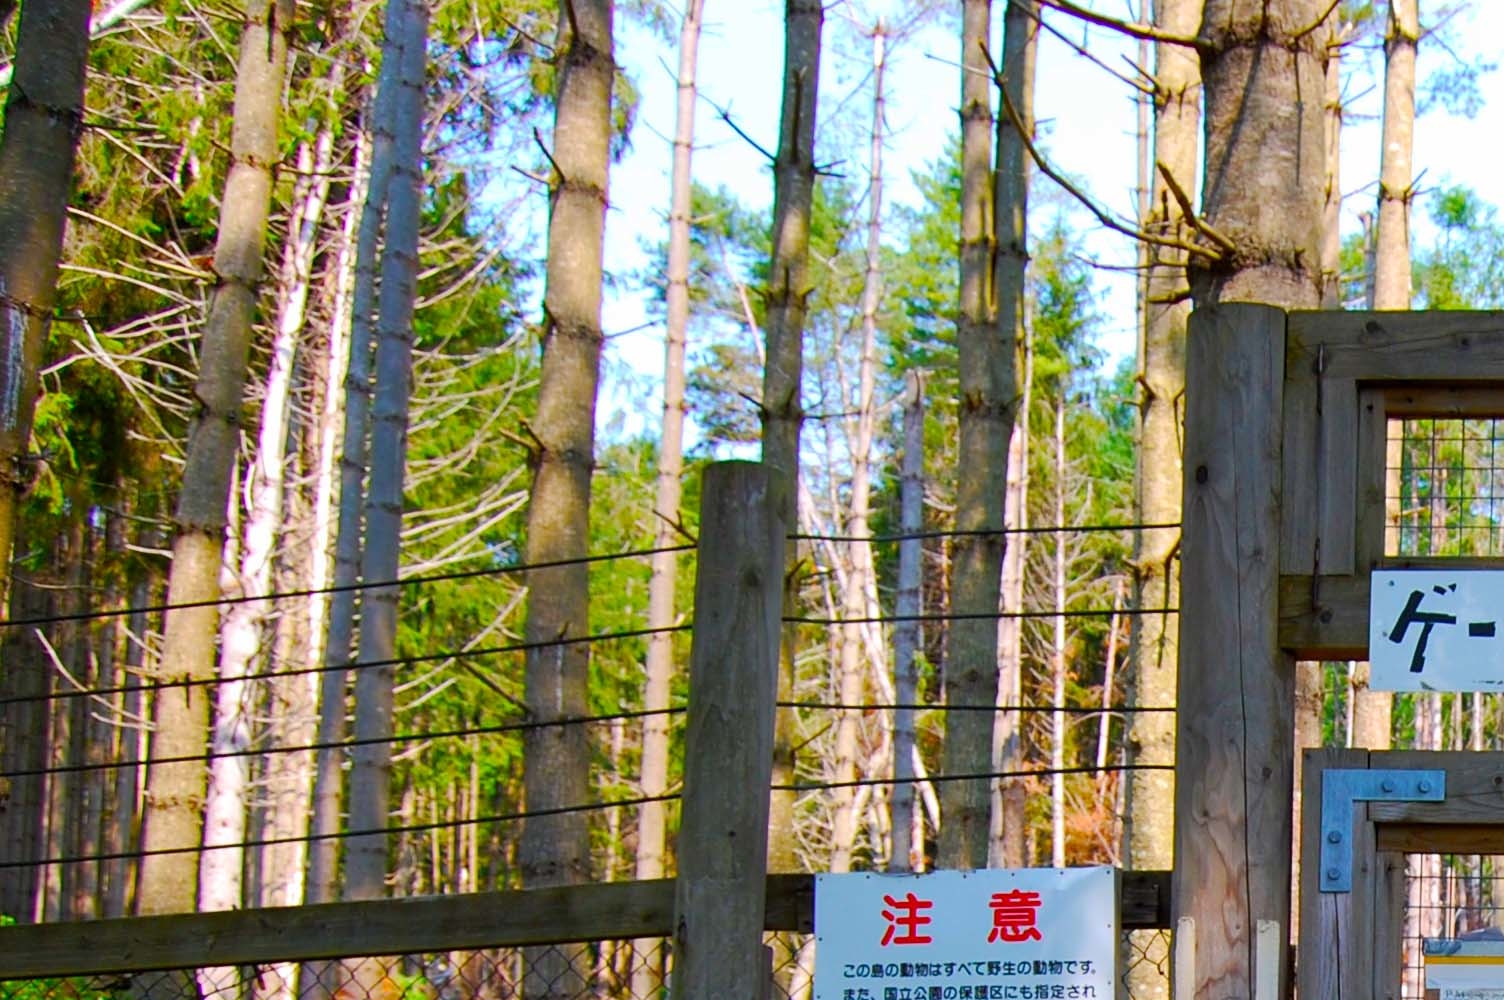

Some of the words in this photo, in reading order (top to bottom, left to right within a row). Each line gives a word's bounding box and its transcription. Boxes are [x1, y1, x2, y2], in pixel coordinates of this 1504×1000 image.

[881, 888, 1042, 947] 注意
[843, 960, 1096, 978] この島の動物はすべて野生の動物です。
